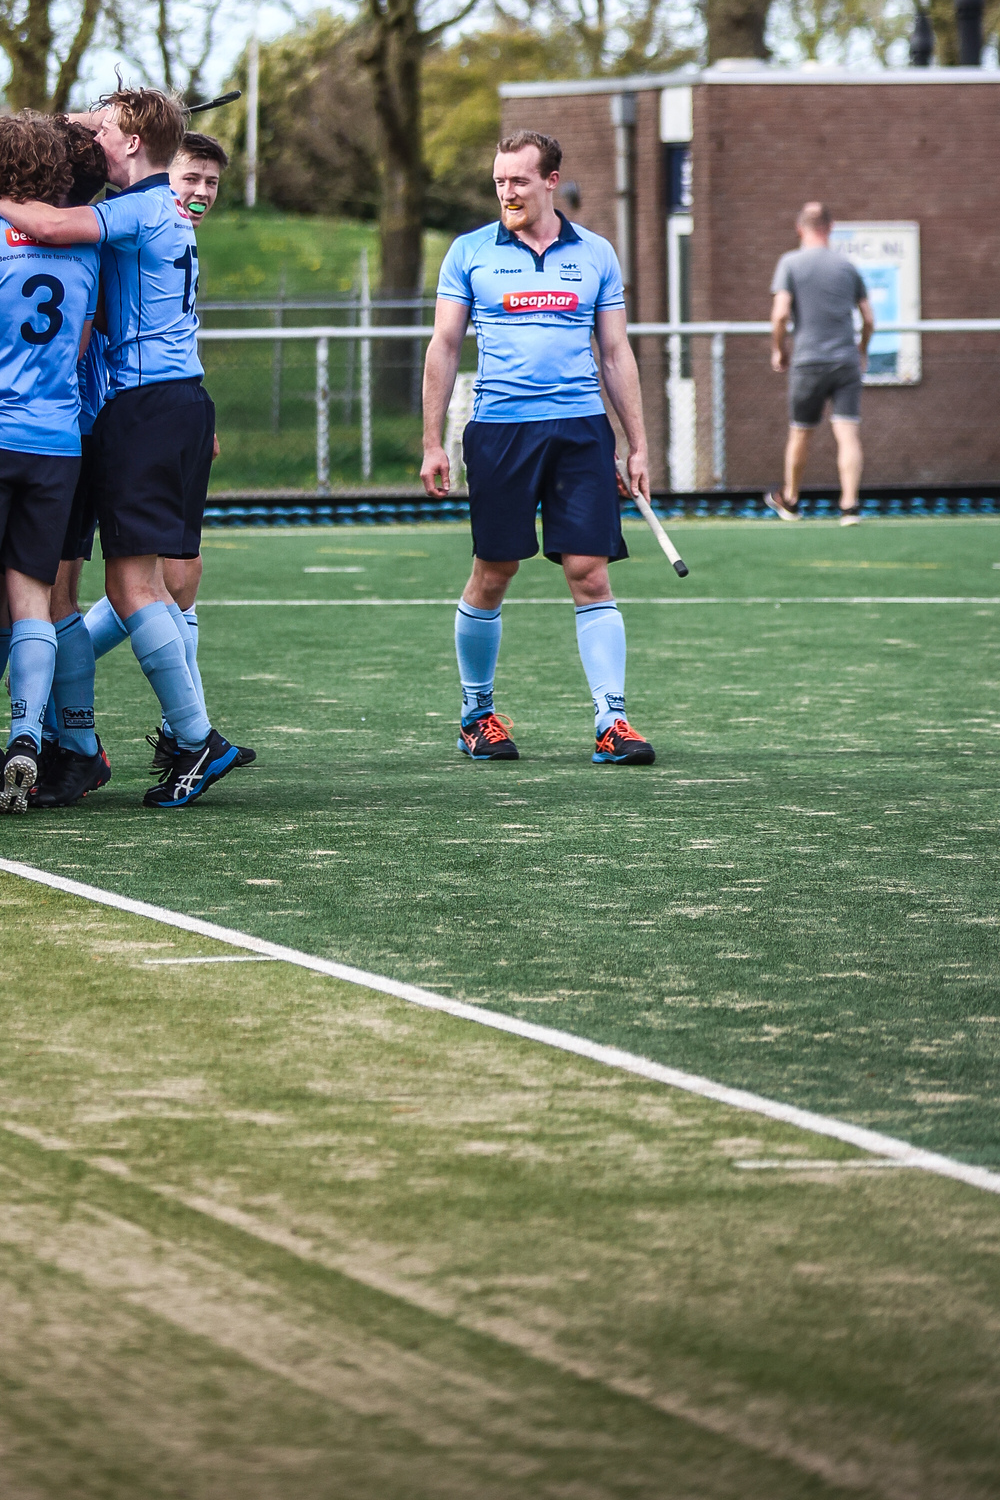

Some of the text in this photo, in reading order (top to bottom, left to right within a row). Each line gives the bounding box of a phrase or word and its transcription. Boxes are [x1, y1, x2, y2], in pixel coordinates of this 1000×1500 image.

[53, 253, 73, 262] family
[510, 294, 573, 307] beaphar
[21, 273, 65, 345] 3
